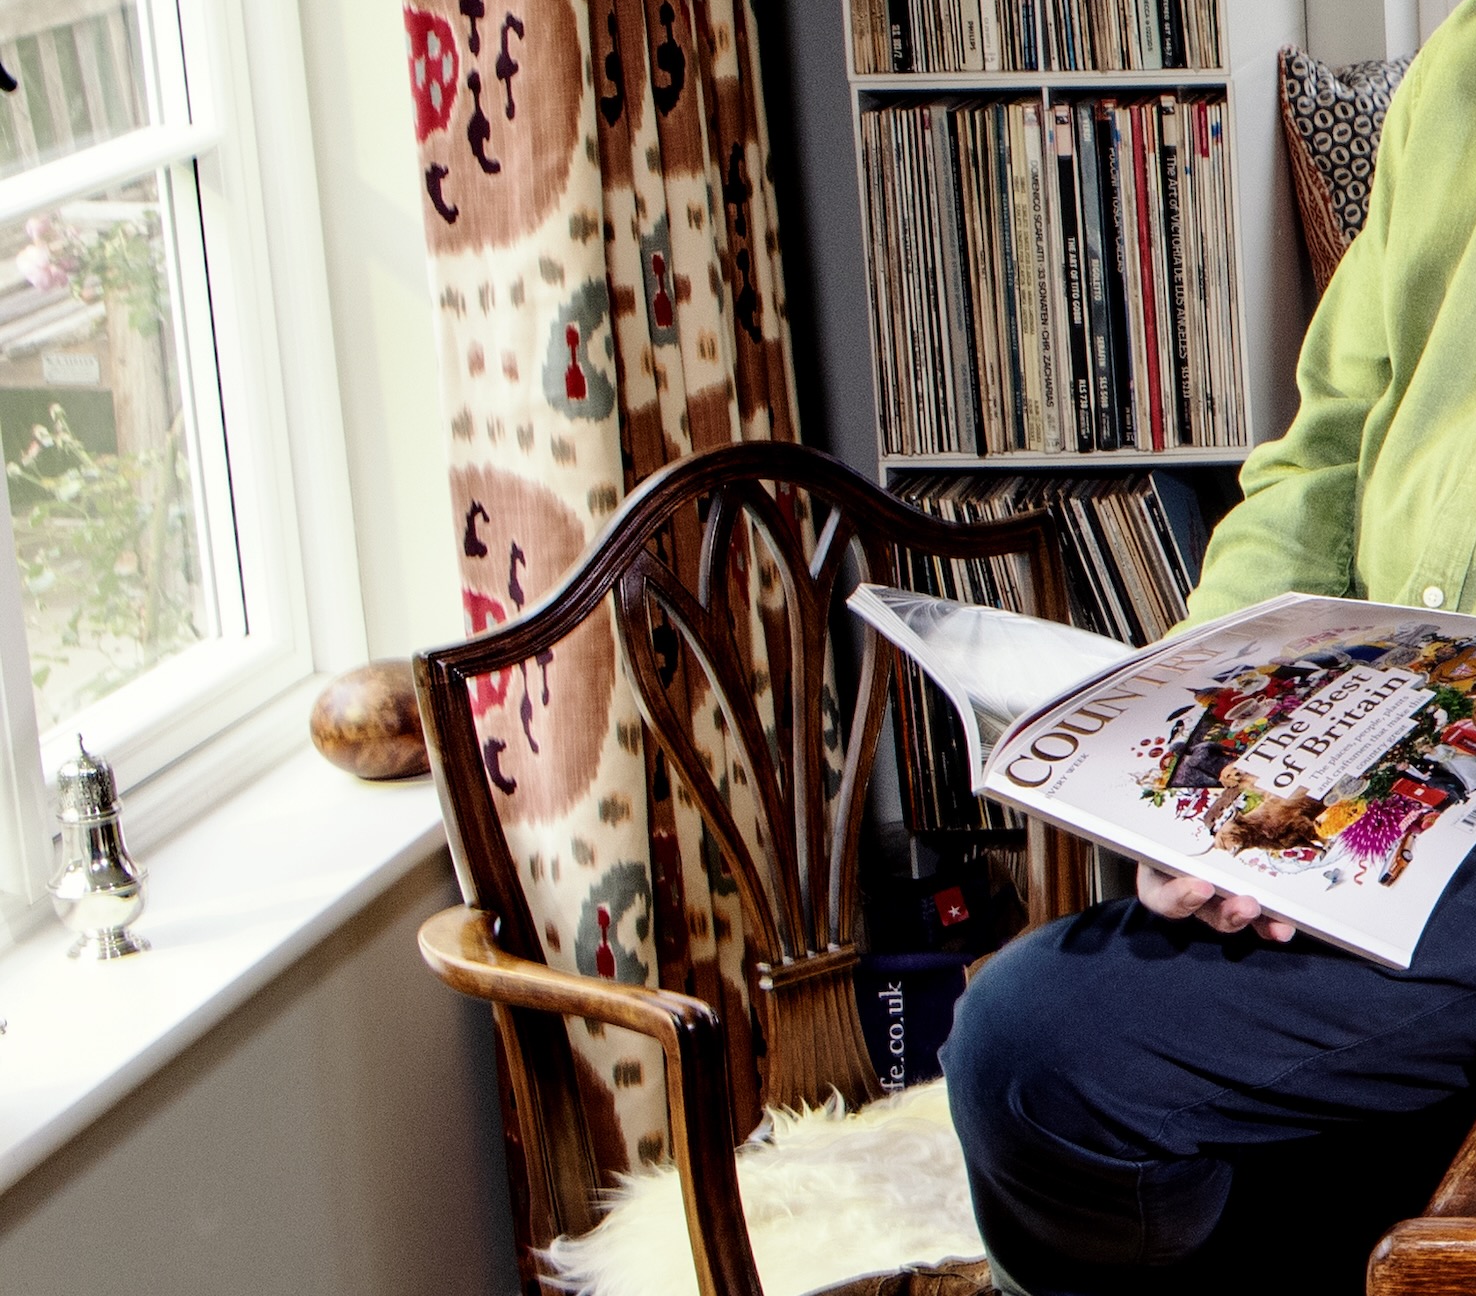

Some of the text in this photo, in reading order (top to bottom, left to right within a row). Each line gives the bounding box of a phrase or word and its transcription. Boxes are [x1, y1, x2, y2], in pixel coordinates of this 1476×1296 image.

[965, 20, 976, 51] PHILIPS
[1029, 159, 1055, 407] DOMENICO SCARLATTI SONATEN ZACHARIAS
[1080, 117, 1107, 390] VERDI RIGOLETTO SERAFIN SLS
[1164, 155, 1190, 359] The Art of VICTORIA DE LOS ANGELES
[1066, 236, 1086, 393] THE ART OF TITO GOBBI RLS
[1006, 643, 1226, 790] COUNTRY
[1063, 750, 1092, 775] WEEK
[1246, 671, 1372, 767] The Best
[1272, 673, 1410, 790] of Britain
[1309, 693, 1409, 781] The places, people, plants
[1316, 692, 1425, 791] and craftsmen that make this
[1354, 723, 1407, 771] country great
[879, 979, 904, 1091] fe.co.uk
